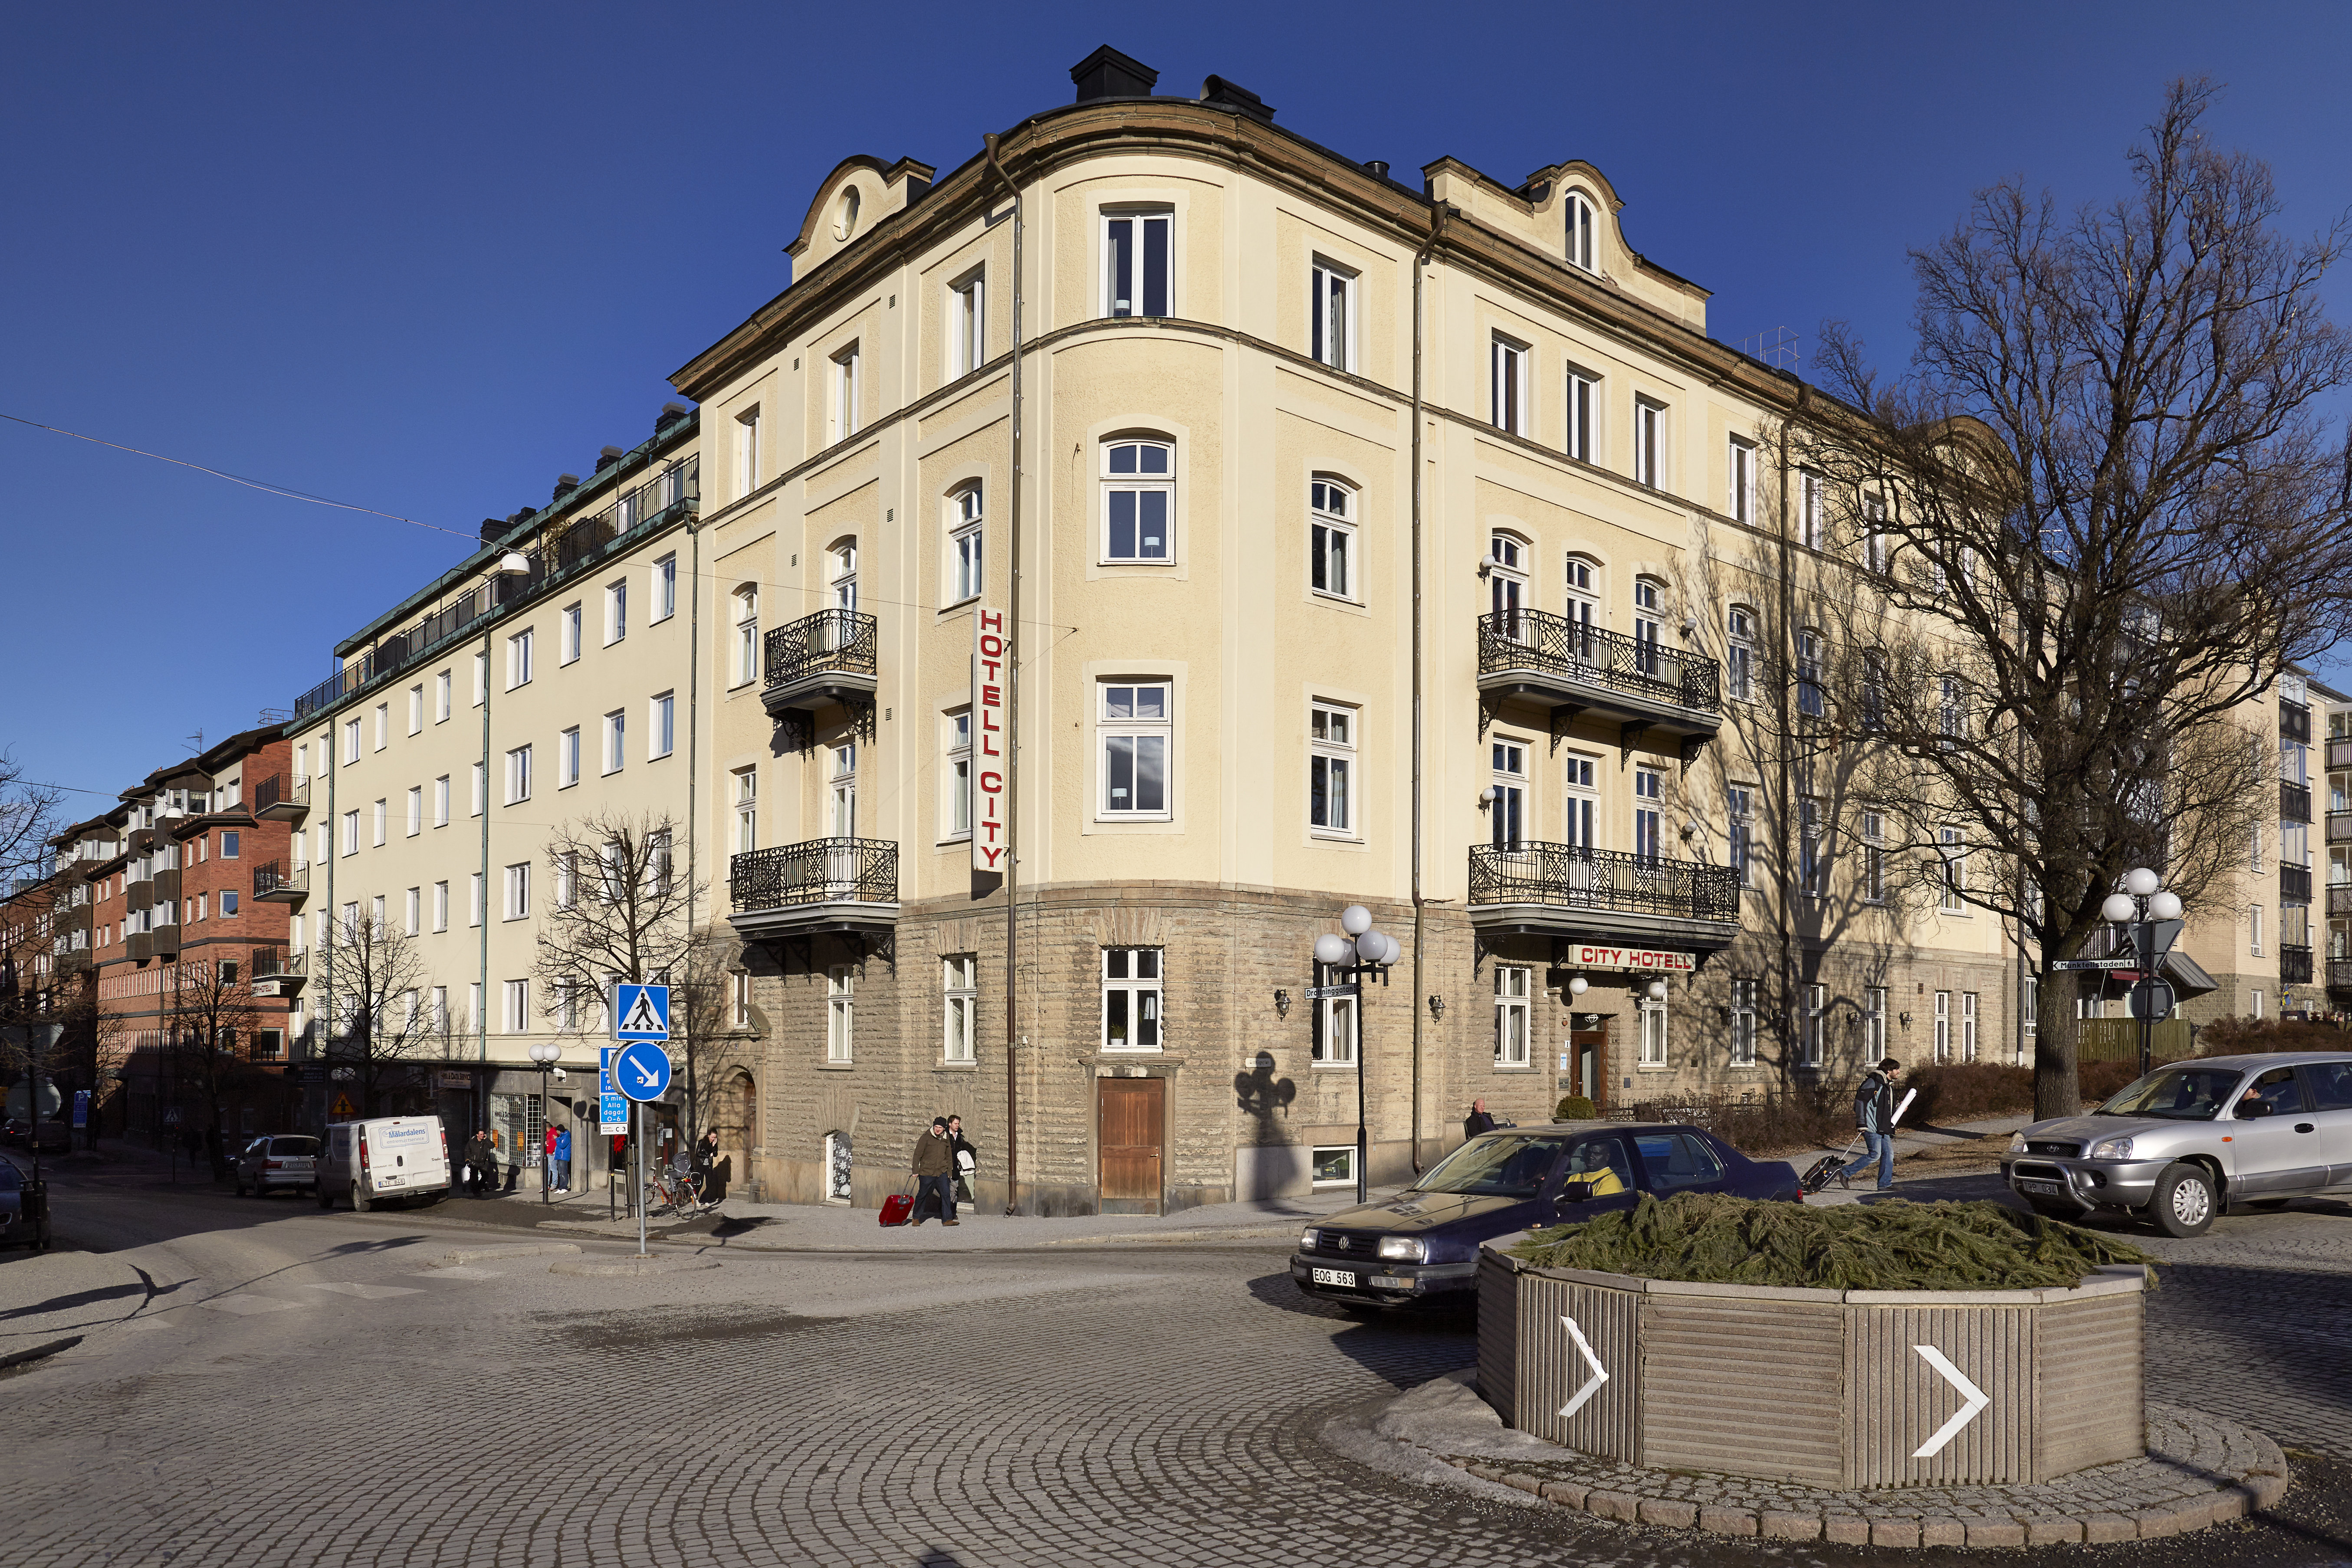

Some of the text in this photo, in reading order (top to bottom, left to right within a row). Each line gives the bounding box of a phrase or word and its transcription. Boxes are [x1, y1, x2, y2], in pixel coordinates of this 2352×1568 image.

[980, 609, 1003, 867] HOTELL CITY
[1582, 948, 1691, 969] CITY HOTELL
[1307, 986, 1353, 997] Drottninggatan
[389, 1128, 425, 1138] Mälardalens
[2042, 1185, 2056, 1194] 084
[1314, 1269, 1353, 1285] EOG 563
